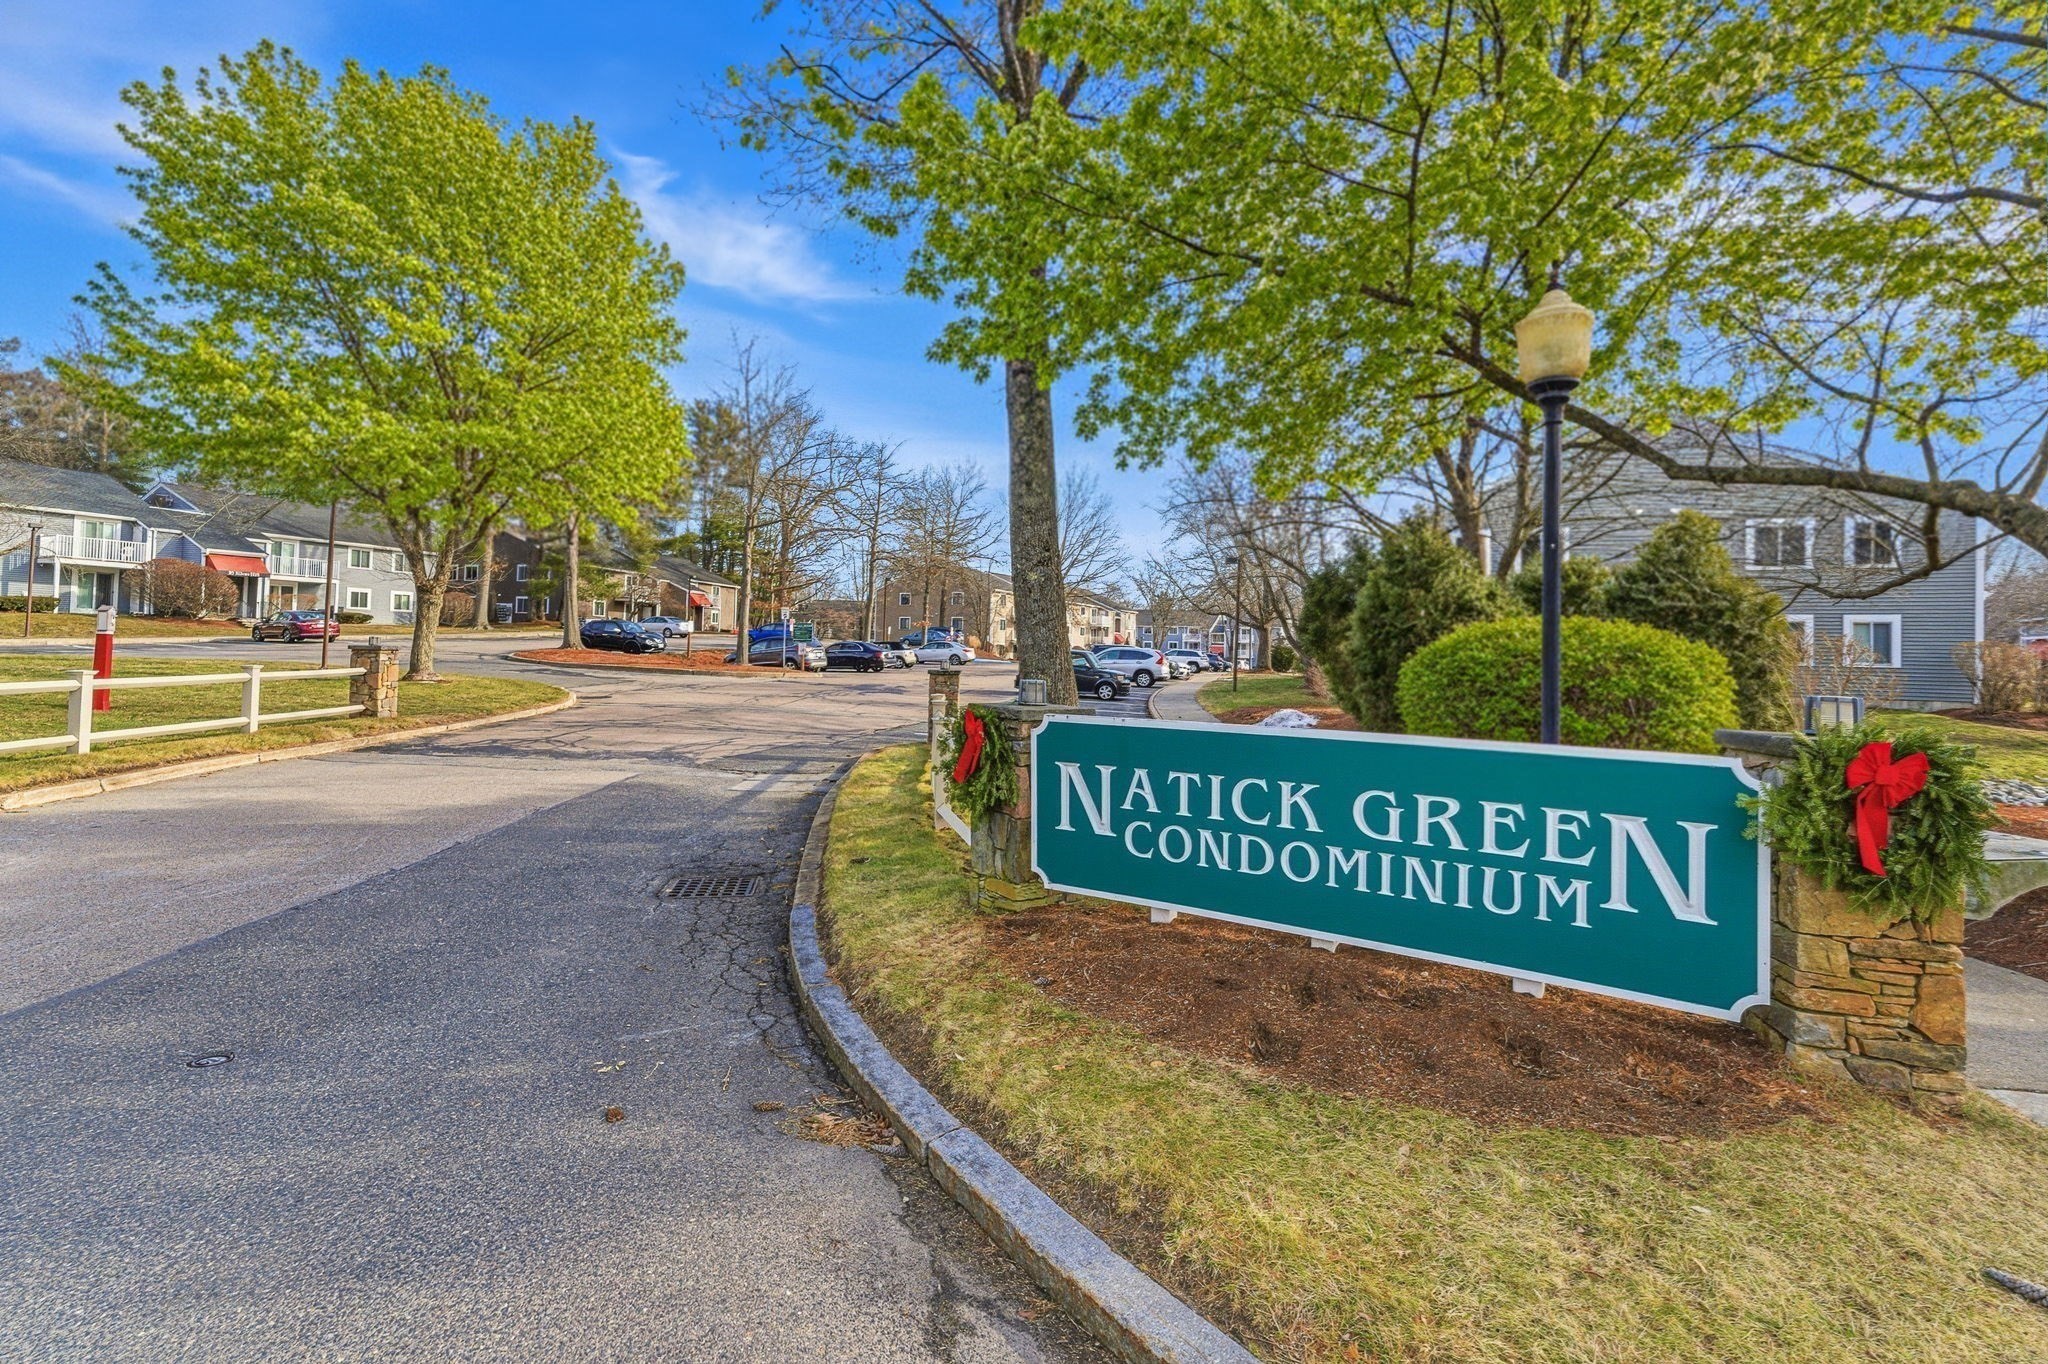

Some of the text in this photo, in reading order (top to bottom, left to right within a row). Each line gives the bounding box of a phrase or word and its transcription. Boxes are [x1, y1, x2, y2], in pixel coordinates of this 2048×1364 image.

[1055, 762, 1718, 926] NATICK GREEN
[1124, 821, 1593, 928] CONDOMINIUM
